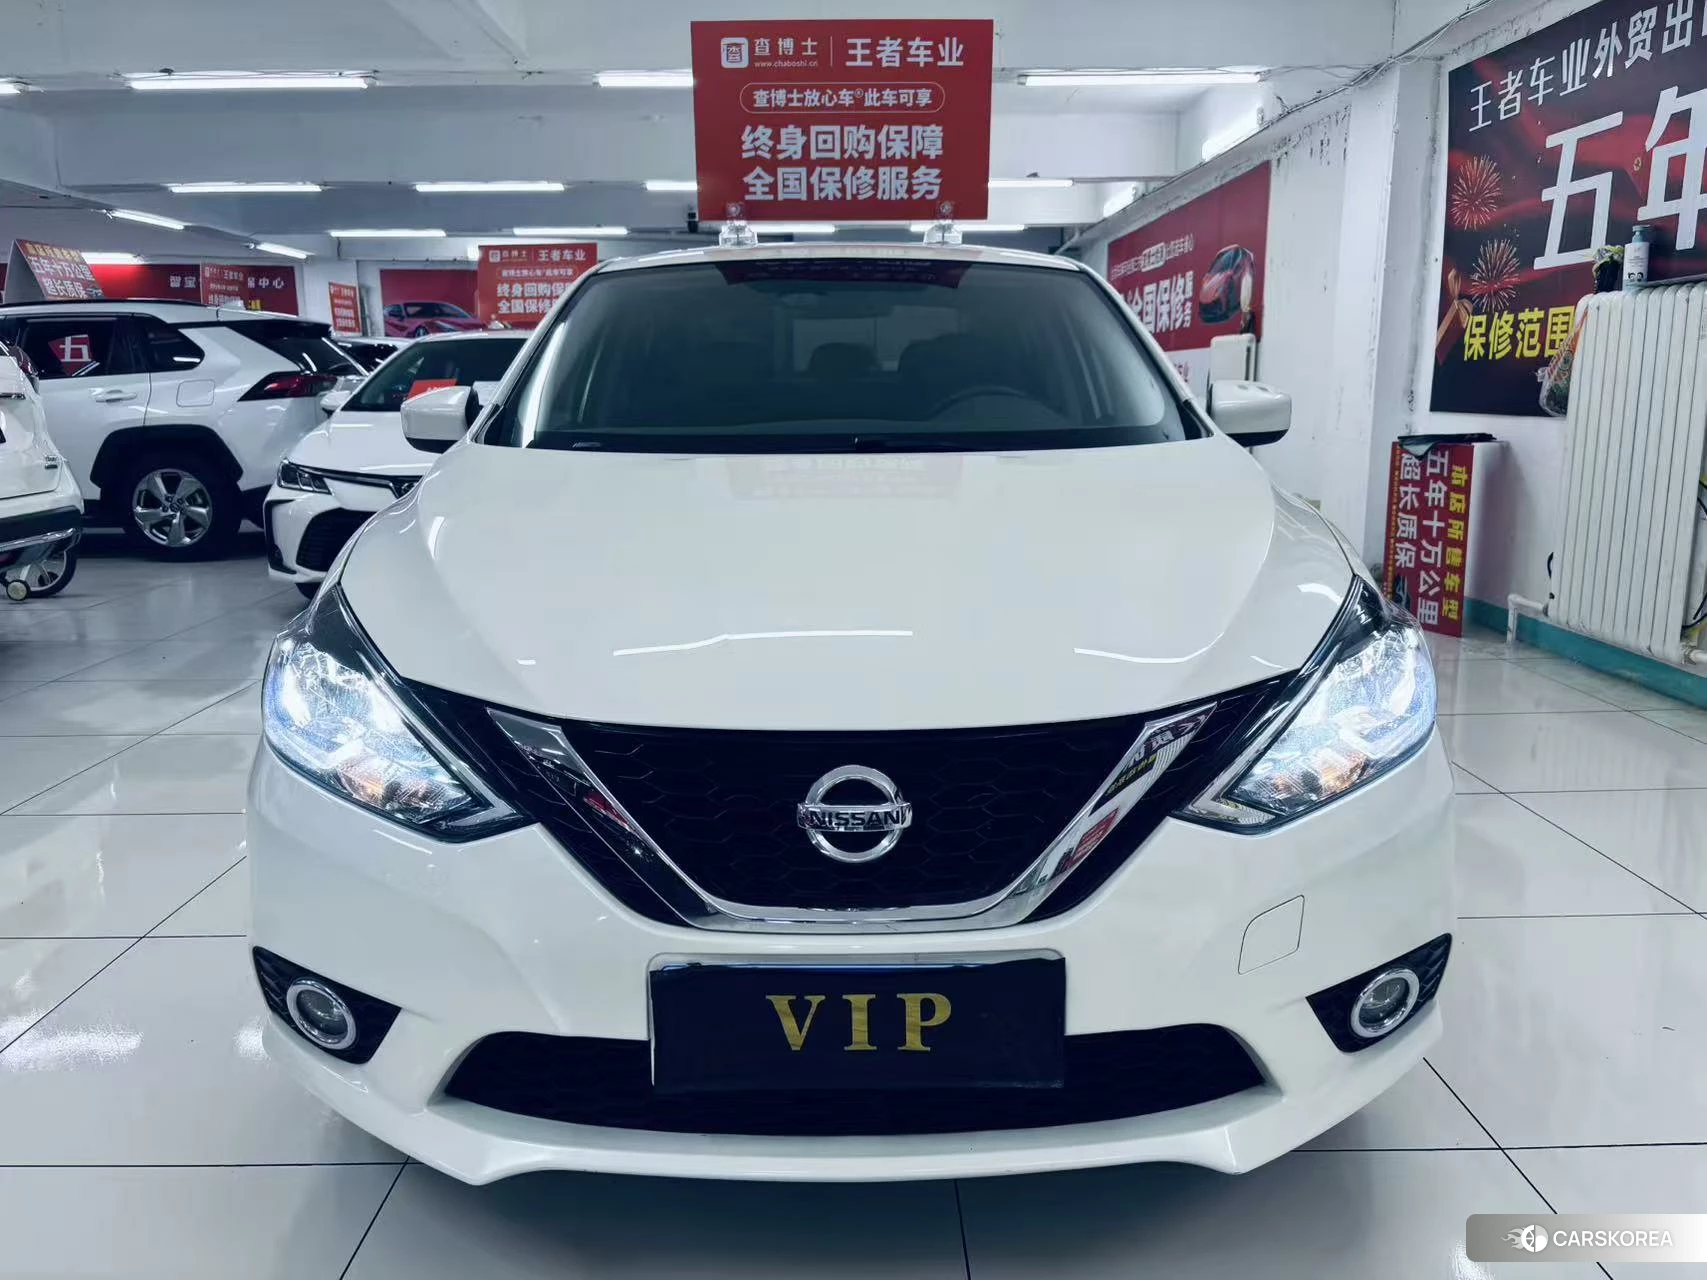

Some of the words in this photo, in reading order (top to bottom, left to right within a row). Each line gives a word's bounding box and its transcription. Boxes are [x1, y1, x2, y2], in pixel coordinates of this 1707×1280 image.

[753, 38, 818, 56] 查博士
[754, 60, 818, 68] www.chaboshi.cn
[845, 37, 965, 67] 王者车业
[1468, 0, 1707, 132] 王者车业外贸出
[741, 124, 944, 160] 终身回购保障
[742, 165, 943, 201] 全国保修服务
[1533, 86, 1707, 270] 五年
[537, 249, 586, 261] 王者车业
[496, 283, 574, 298] 终身回购保
[497, 299, 557, 314] 全国保修
[1121, 273, 1184, 333] 全国保修
[1463, 306, 1576, 362] 保修范围
[1394, 453, 1423, 569] 超长质保
[1416, 450, 1450, 626] 五年十万公里
[1441, 464, 1469, 621] 本店所售车型
[809, 811, 901, 827] NISSAN
[765, 993, 952, 1052] VIP
